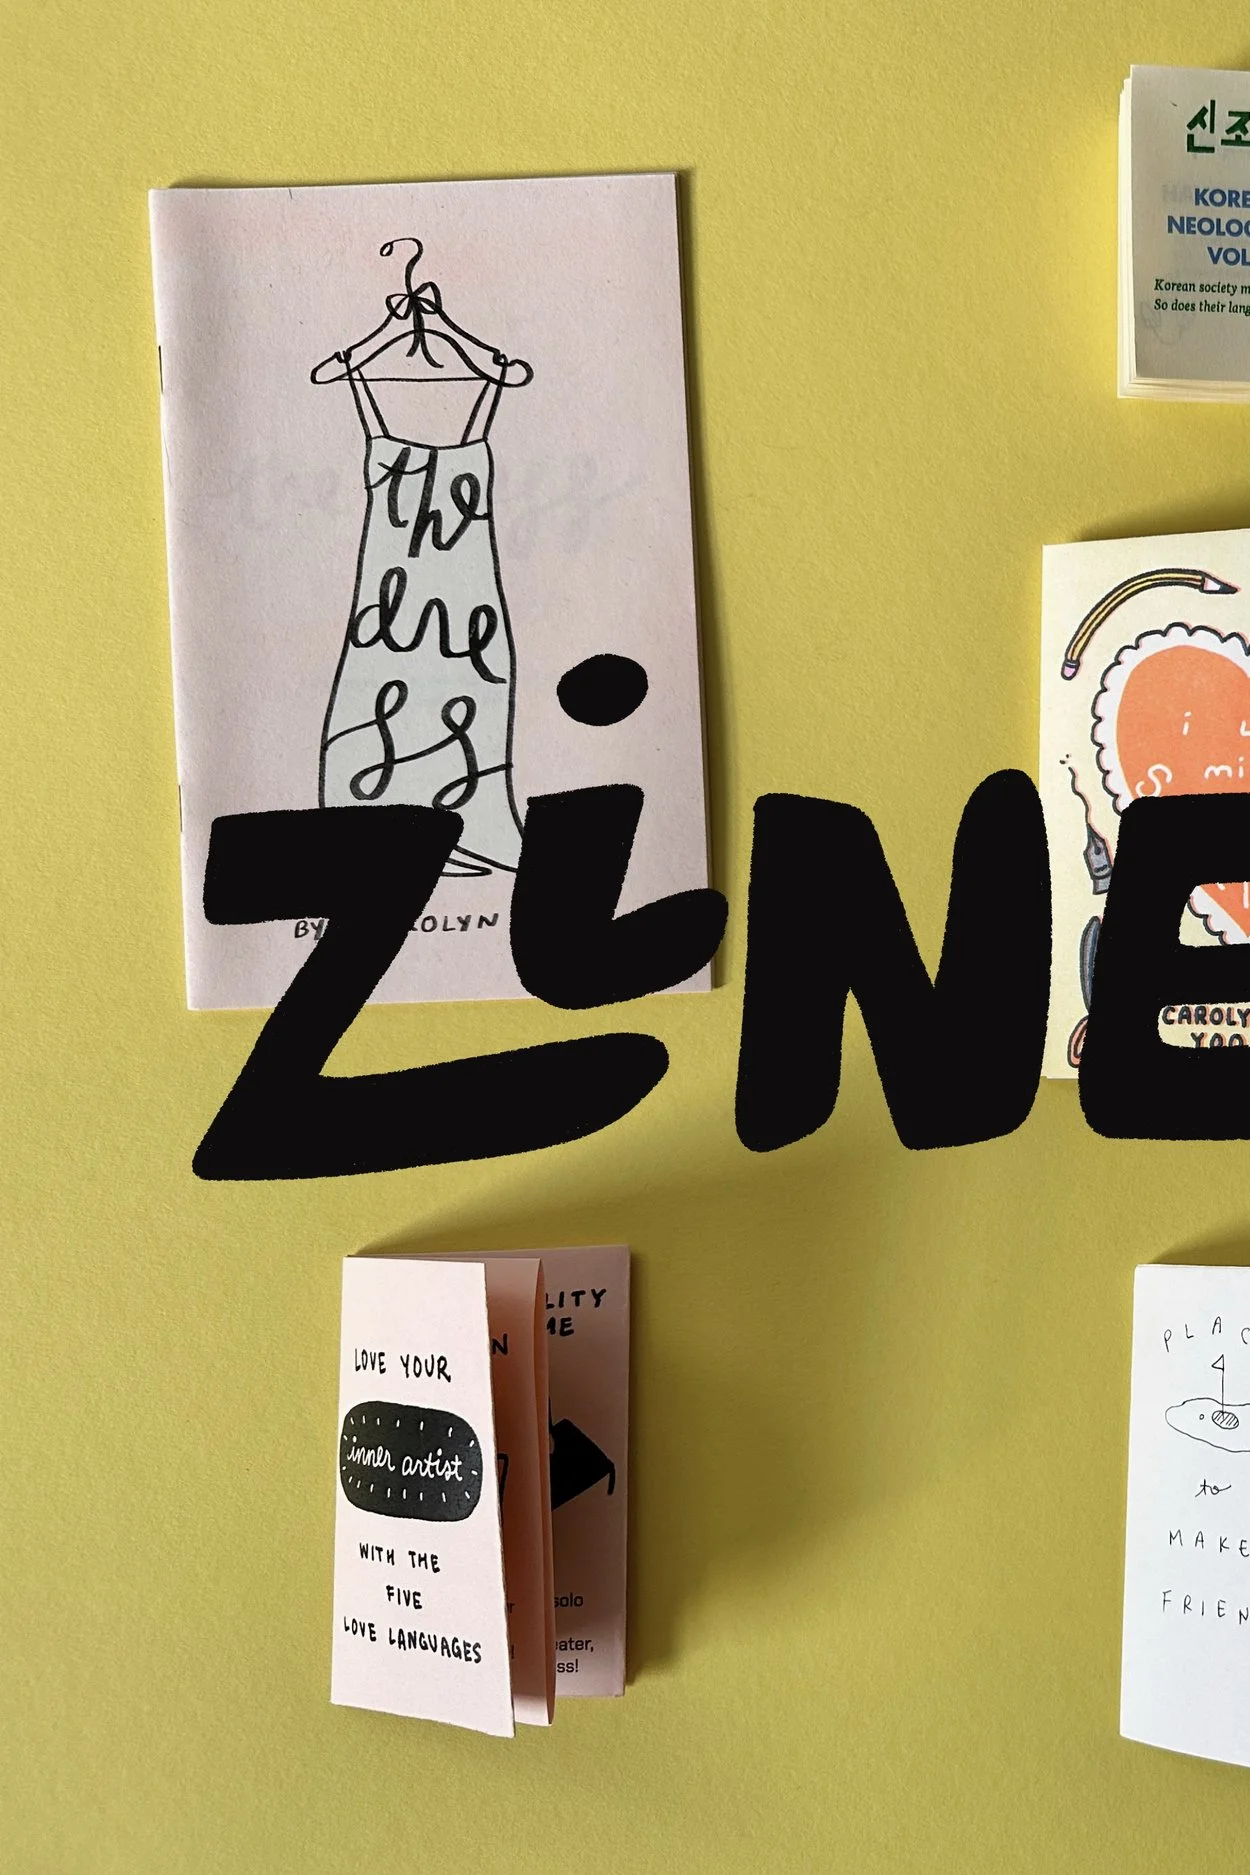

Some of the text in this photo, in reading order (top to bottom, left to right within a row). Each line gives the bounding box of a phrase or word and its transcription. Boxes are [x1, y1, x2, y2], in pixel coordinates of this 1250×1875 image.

[1154, 279, 1196, 293] Korean
[1199, 281, 1238, 296] society
[1154, 298, 1168, 311] So
[1171, 299, 1196, 312] does
[1199, 300, 1226, 314] their
[366, 447, 491, 558] the
[294, 913, 499, 941] BY OLYN
[354, 1348, 452, 1383] LOVE YOUR
[346, 1435, 464, 1481] inner artist
[1195, 1478, 1232, 1498] to
[359, 1542, 441, 1574] WITH THE
[1169, 1529, 1250, 1558] MAKE
[386, 1585, 423, 1611] FIVE
[344, 1617, 377, 1644] LOVE
[389, 1628, 482, 1664] LANGUAGES
